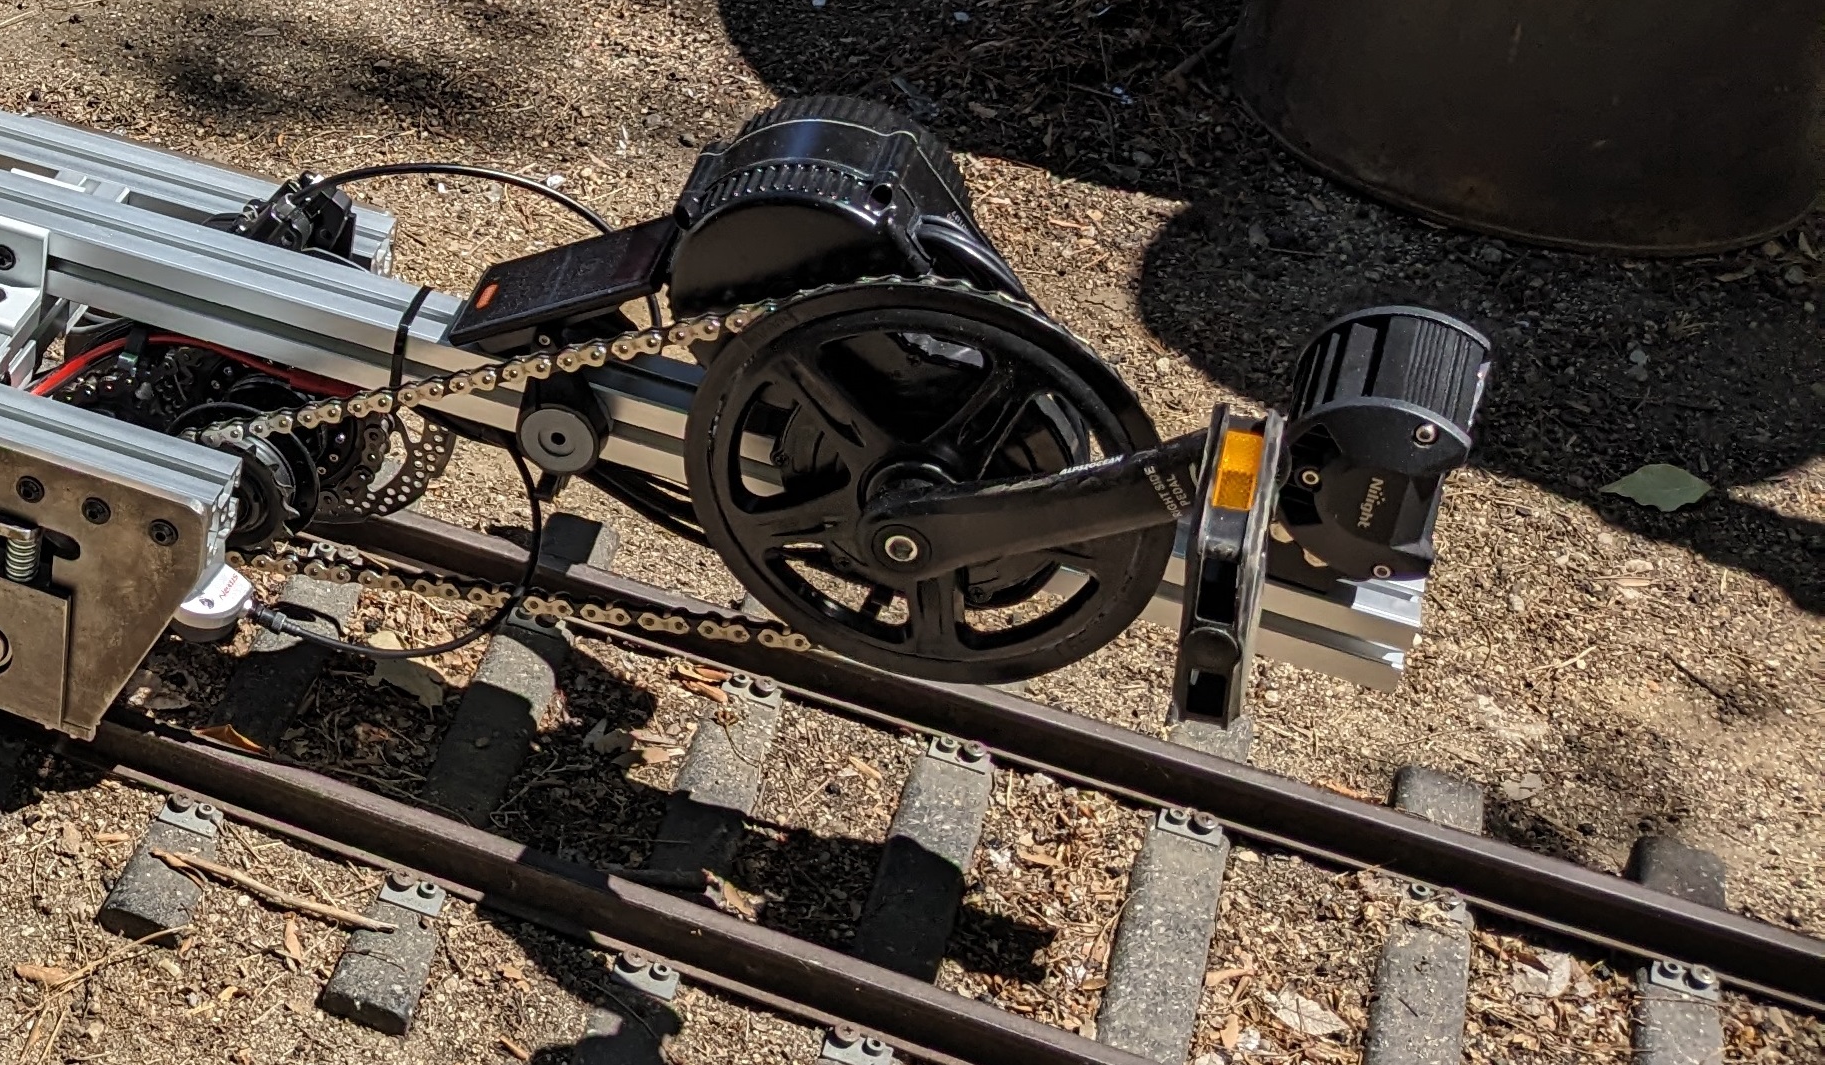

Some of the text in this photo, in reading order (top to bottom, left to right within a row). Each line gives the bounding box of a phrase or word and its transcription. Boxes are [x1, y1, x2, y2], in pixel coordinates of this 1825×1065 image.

[1144, 465, 1165, 492] SIDE
[1167, 474, 1191, 507] PEDAL
[219, 573, 239, 601] Nexus
